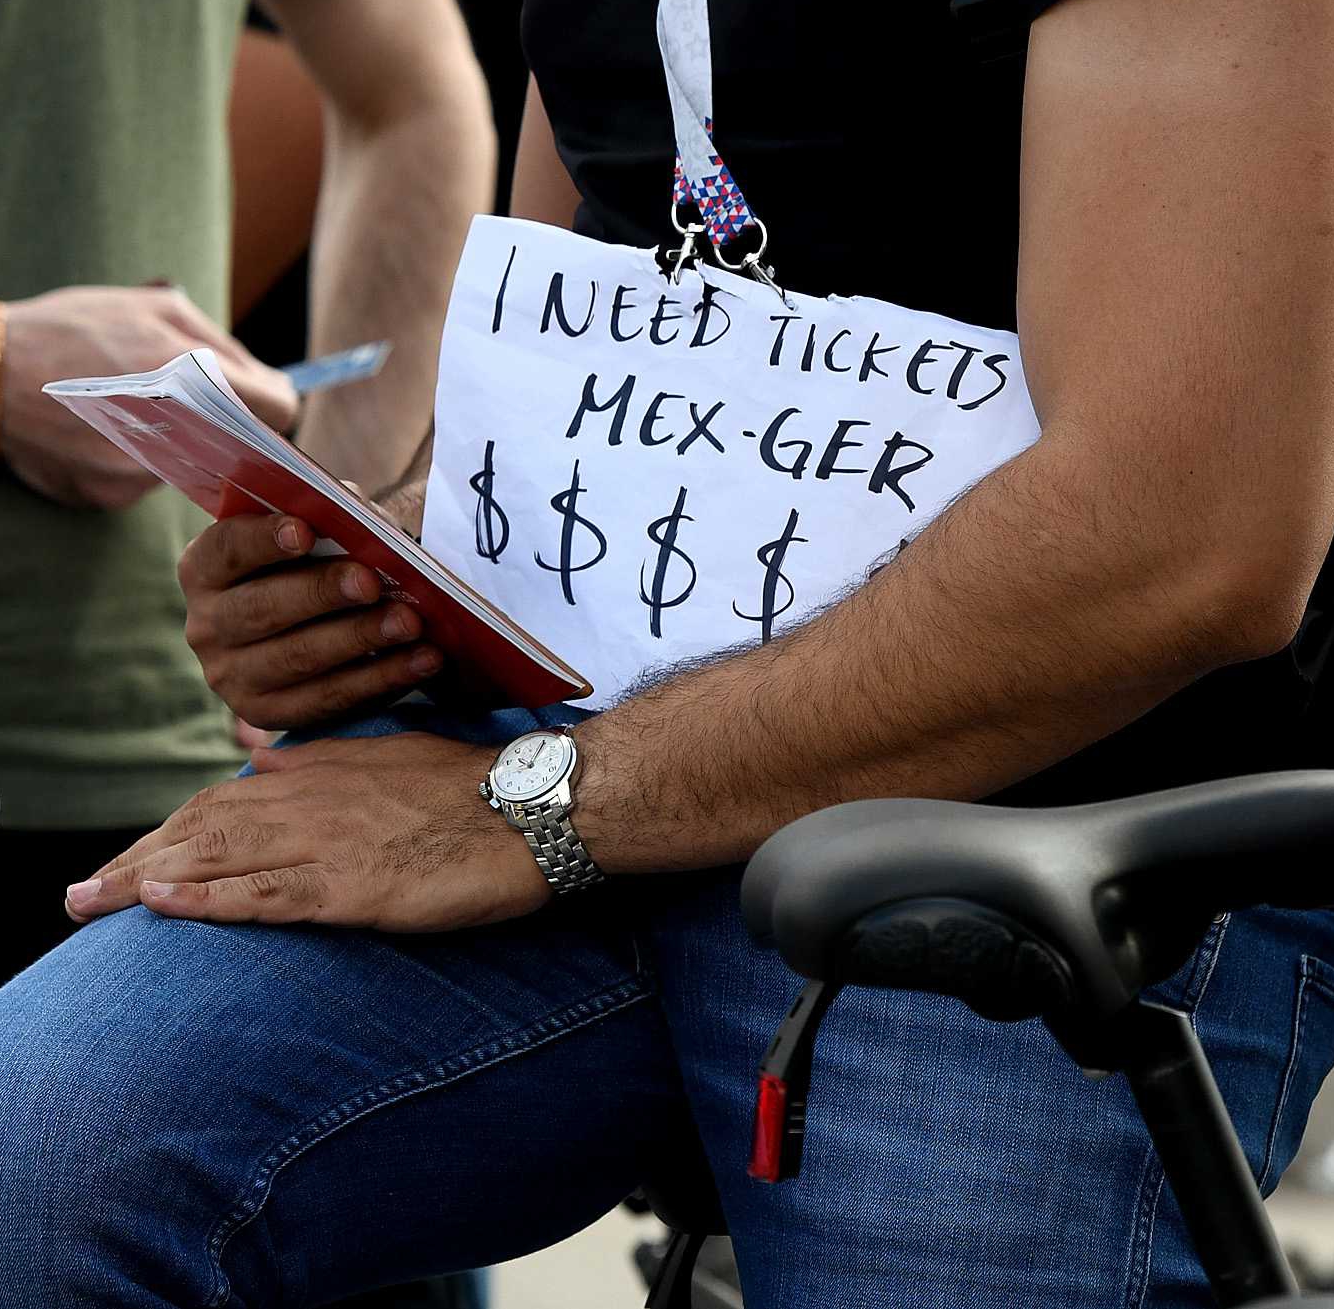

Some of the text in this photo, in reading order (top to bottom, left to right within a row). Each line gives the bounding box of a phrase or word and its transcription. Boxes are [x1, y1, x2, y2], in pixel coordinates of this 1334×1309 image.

[492, 245, 1010, 410] I NEED TICKETS
[566, 373, 933, 512] MEX-GER
[470, 440, 808, 644] $ $ $ $
